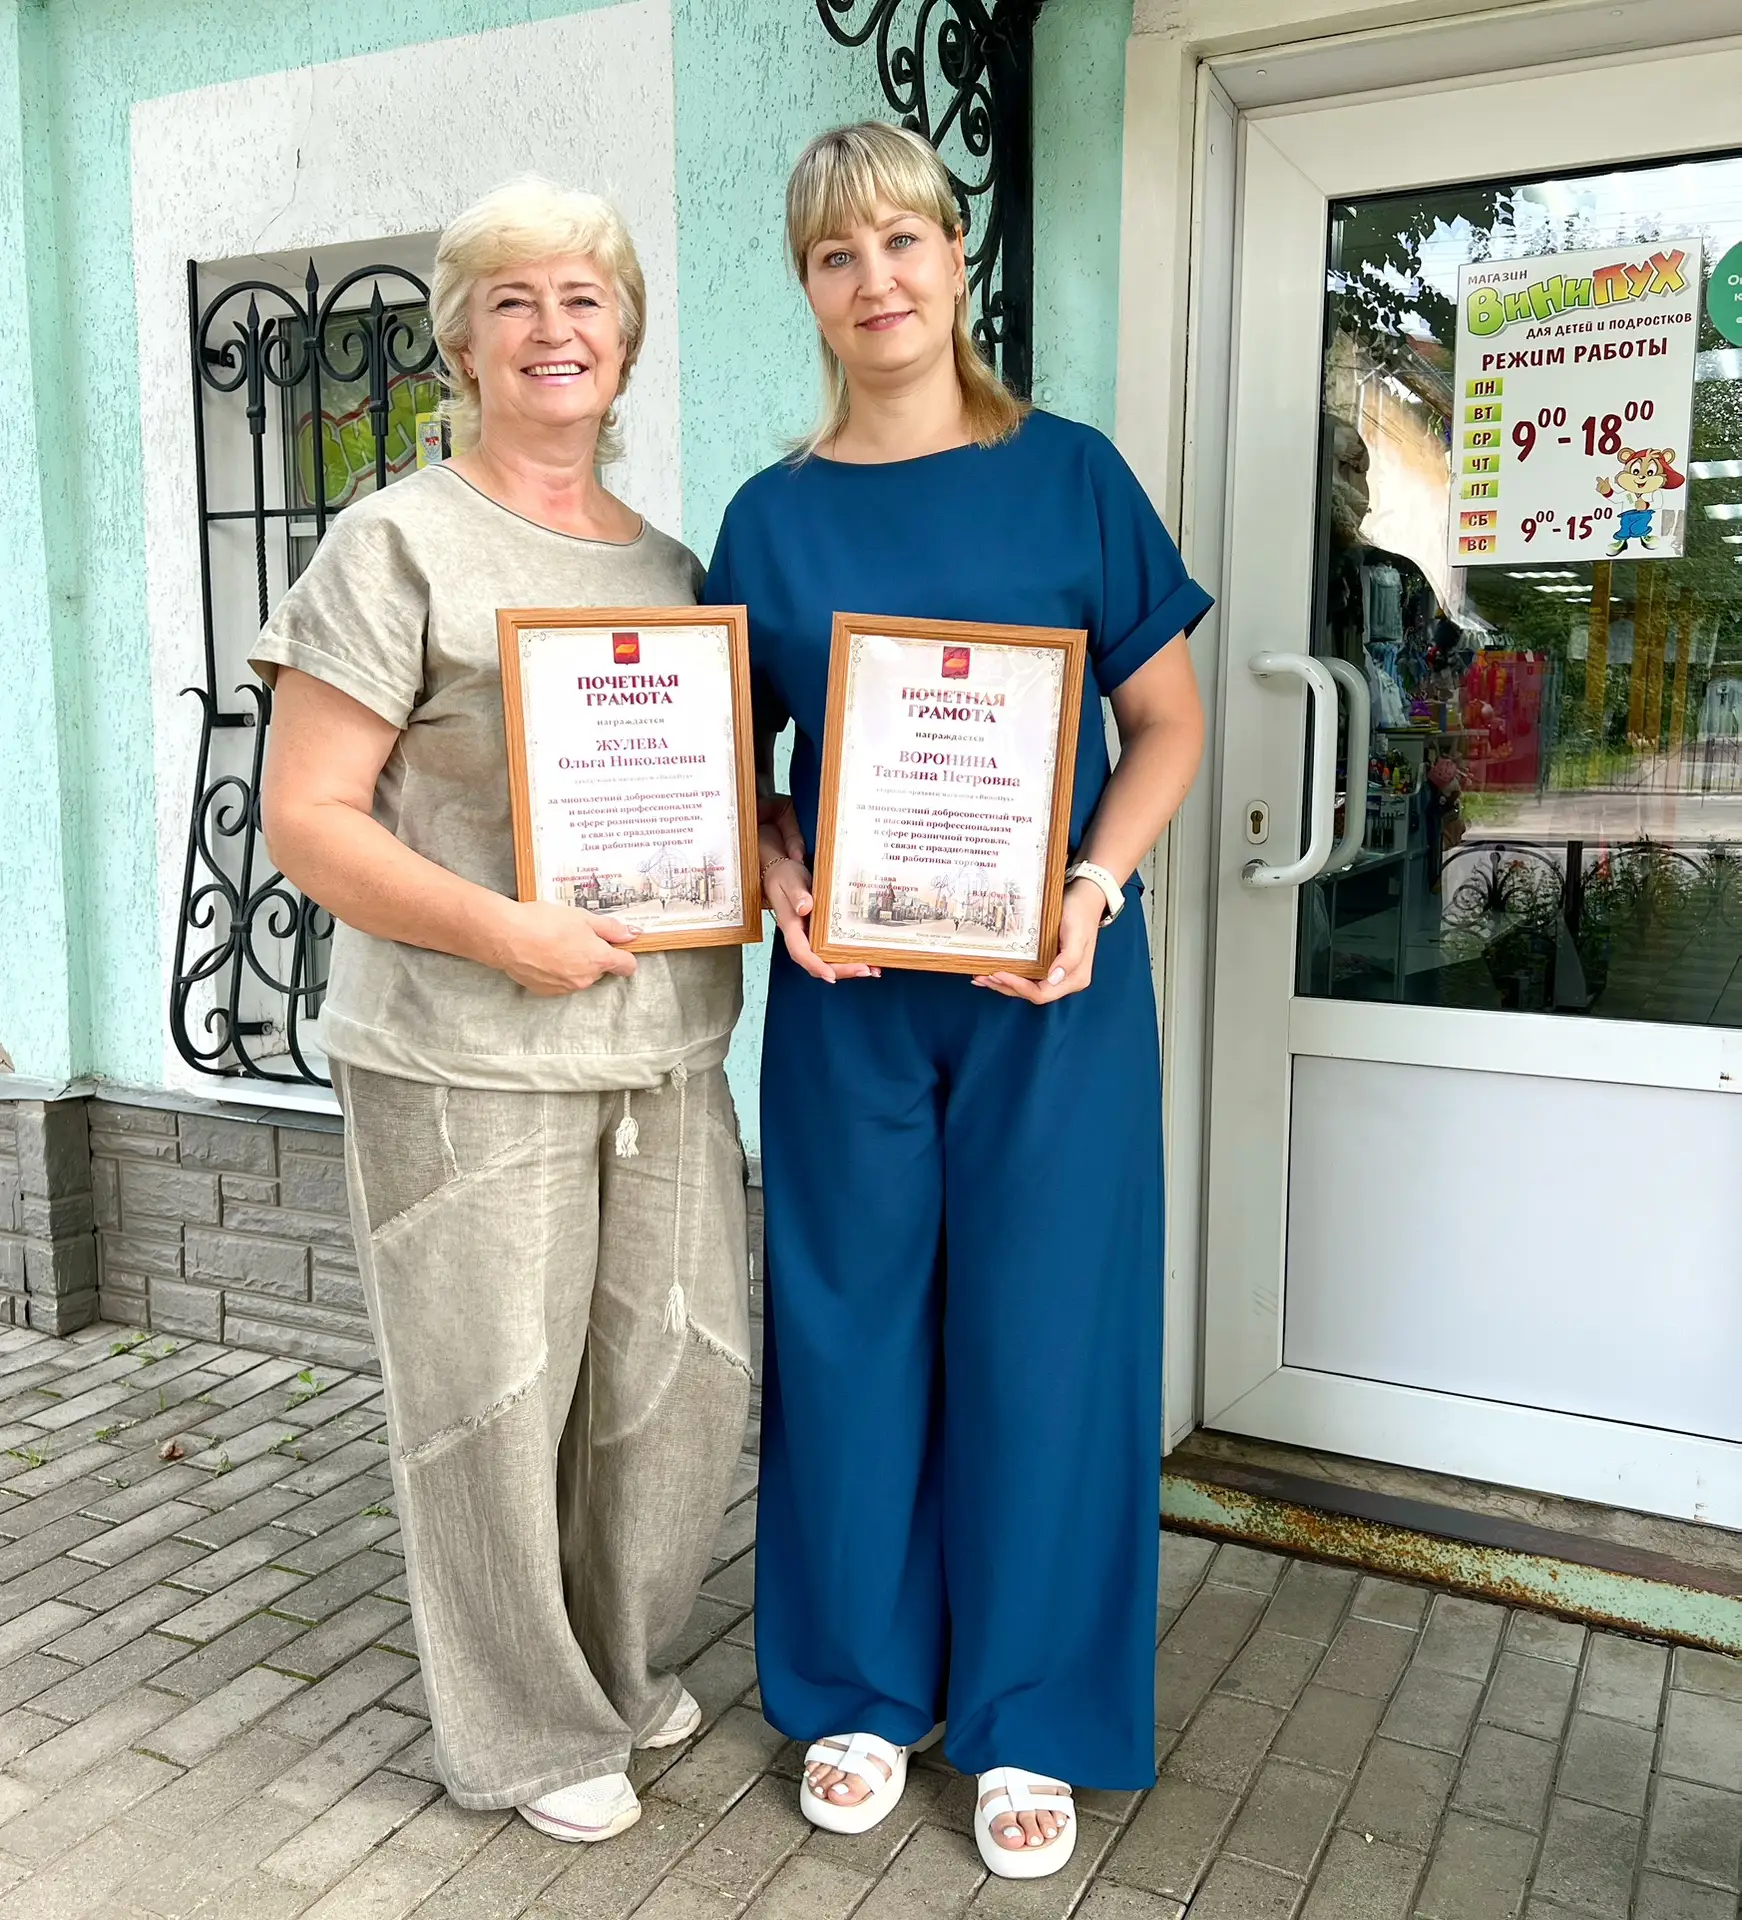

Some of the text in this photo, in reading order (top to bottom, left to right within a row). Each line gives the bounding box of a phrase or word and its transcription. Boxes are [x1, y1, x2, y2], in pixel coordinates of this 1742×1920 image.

[1467, 269, 1528, 285] МАГАЗИН
[1526, 312, 1692, 340] ДЛЯ ДЕТЕЙ И ПОДРОСТКОВ
[1482, 338, 1668, 371] РЕЖИМ РАБОТЫ
[1474, 380, 1495, 395] ПН
[1474, 407, 1493, 420] ВТ
[1472, 432, 1492, 446] СР
[1472, 457, 1490, 471] ЧТ
[1471, 483, 1490, 496] ПТ
[1468, 513, 1488, 526] СБ
[1467, 539, 1488, 551] ВС
[577, 674, 680, 690] ПОЧЕТНАЯ
[586, 691, 673, 706] ГРАМОТА
[901, 687, 1006, 707] ПОЧЕТНАЯ
[908, 704, 997, 723] ГРАМОТА
[597, 717, 665, 728] награждается
[915, 731, 985, 742] награждается
[596, 737, 669, 752] ЖУЛЕВА
[558, 754, 706, 770] Ольга Николаевна
[899, 751, 998, 769] ВОРОНИНА
[873, 765, 1021, 788] Татьяна Петровна
[548, 789, 721, 805] за многолетний добросовестный труд
[577, 805, 618, 815] высокий
[620, 803, 703, 815] профессионализм
[867, 804, 930, 816] многолетний
[931, 808, 1010, 821] добросовестный
[1011, 813, 1033, 824] труд
[577, 818, 605, 829] сфере
[606, 816, 658, 828] розничной
[883, 816, 924, 827] высокий
[926, 820, 1012, 834] профессионализм
[588, 831, 614, 839] связи
[623, 827, 694, 839] празднованием
[880, 829, 909, 839] сфере
[910, 831, 963, 843] розничной
[581, 838, 694, 852] Дня работника торговли
[890, 842, 917, 851] связи
[925, 844, 999, 857] празднованием
[882, 852, 997, 870] Дня работника торговли
